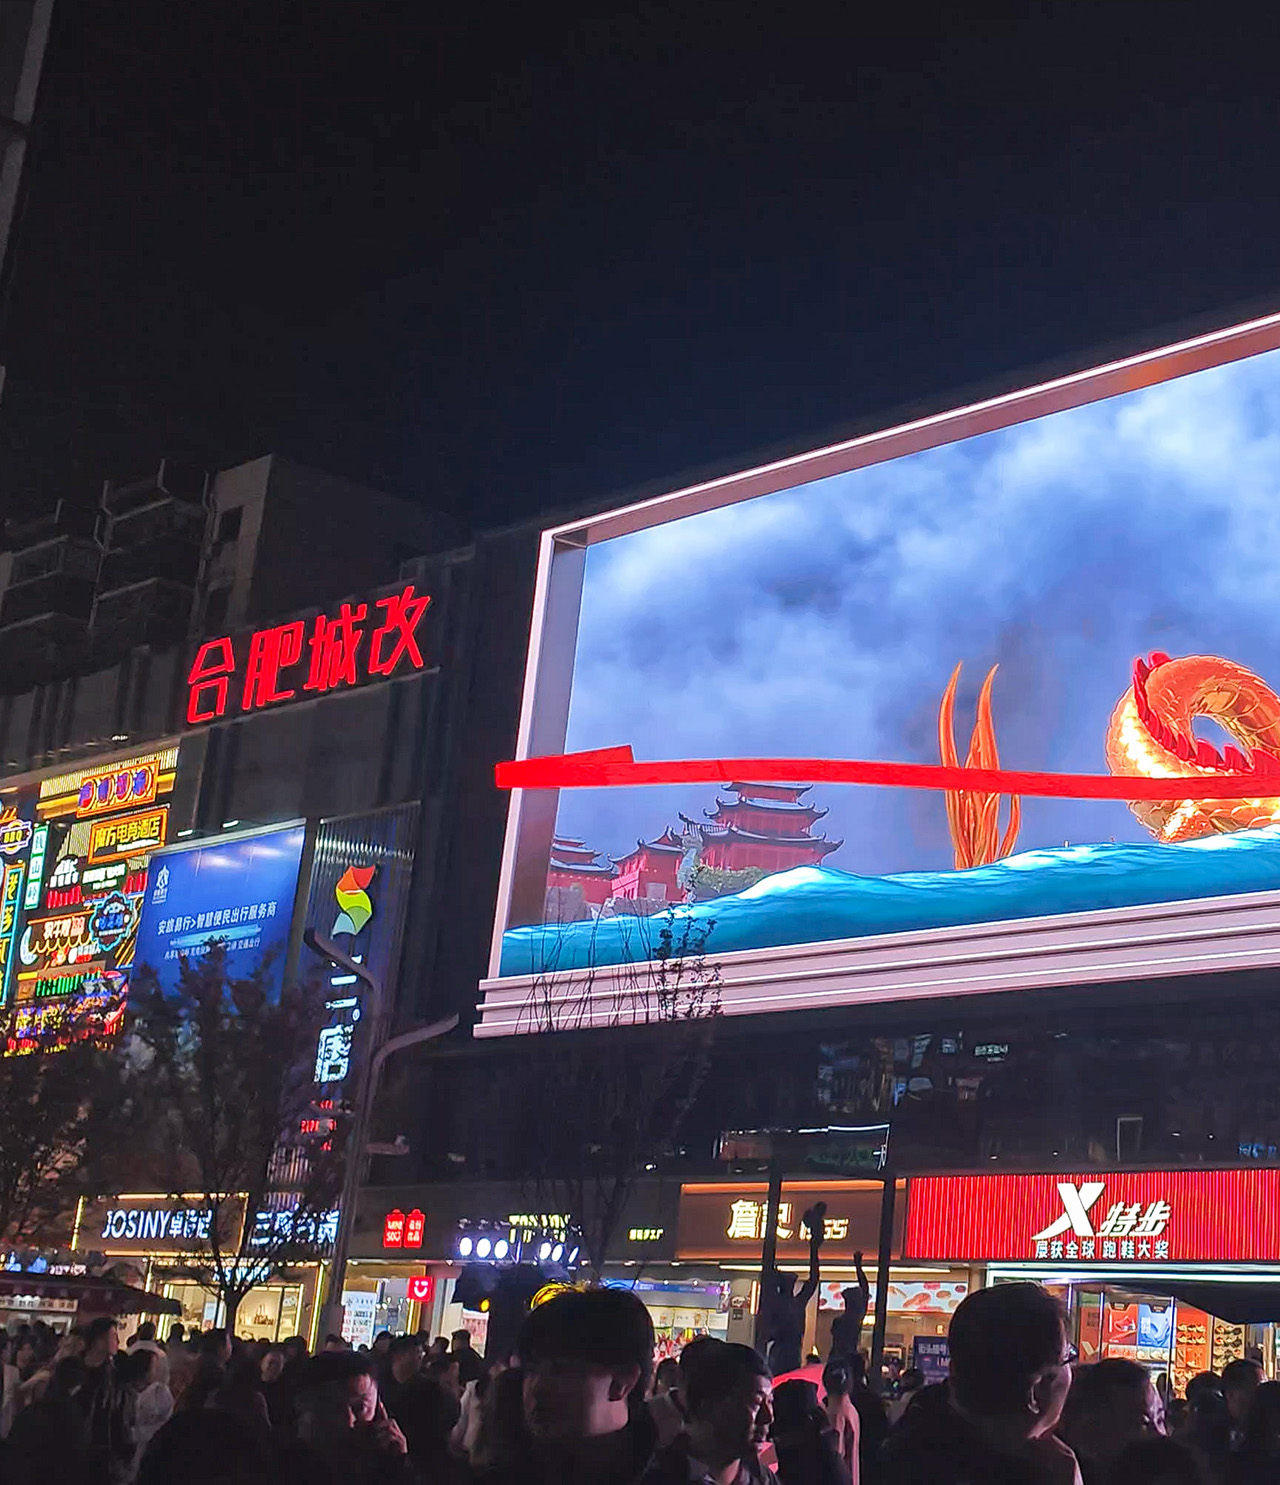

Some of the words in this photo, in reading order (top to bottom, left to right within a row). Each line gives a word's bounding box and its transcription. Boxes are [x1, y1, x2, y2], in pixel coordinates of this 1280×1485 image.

[187, 585, 431, 723] 合肥城改
[1095, 1200, 1172, 1237] 特步
[1102, 1240, 1169, 1259] 跑鞋大奖
